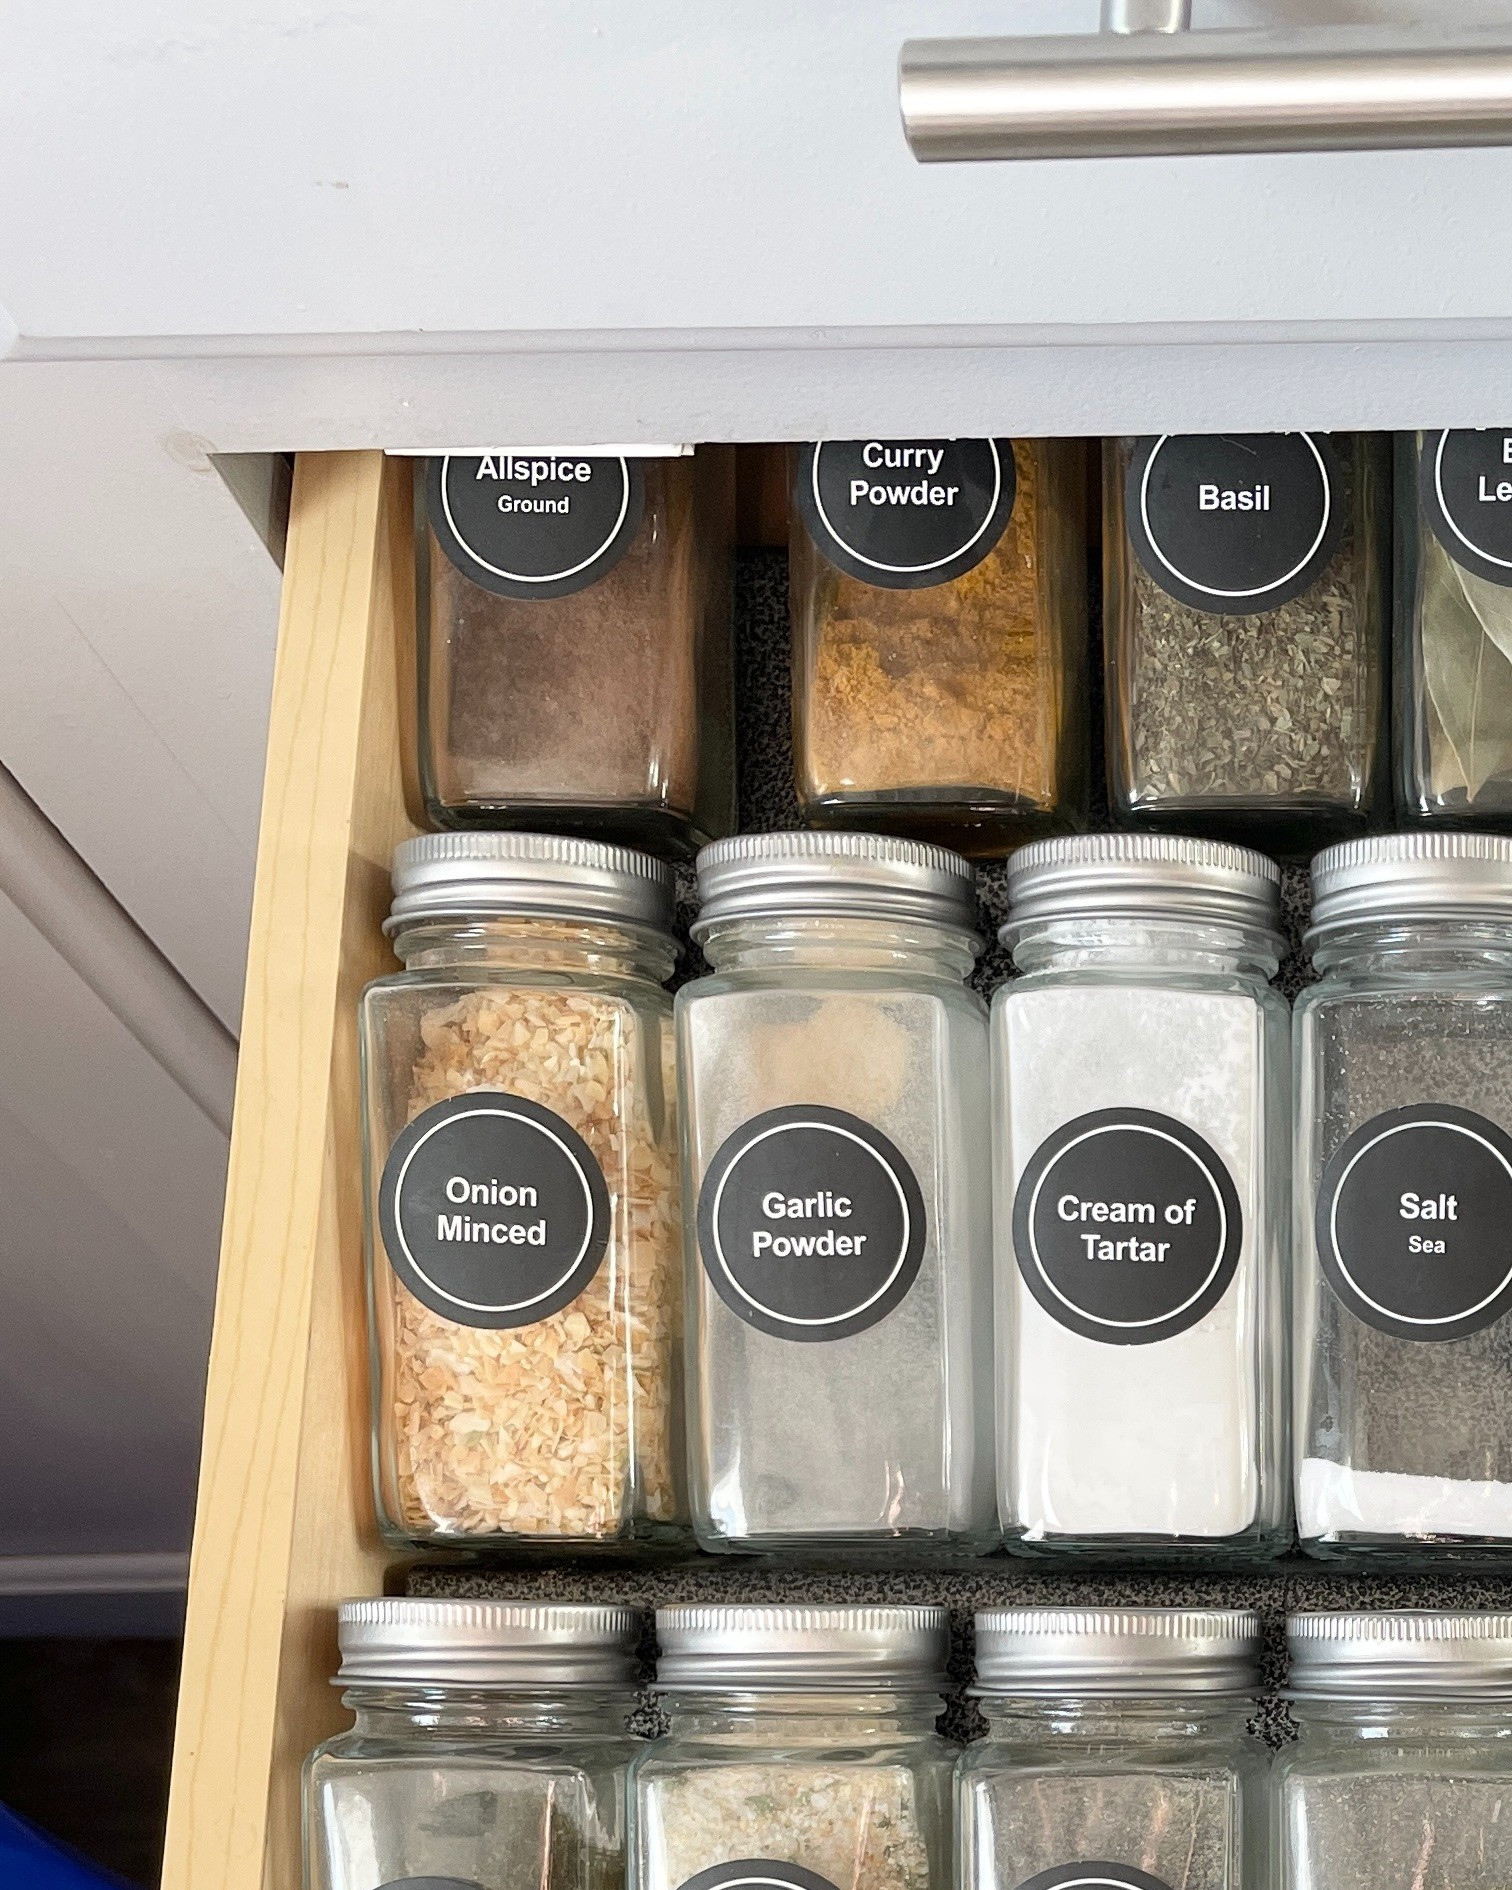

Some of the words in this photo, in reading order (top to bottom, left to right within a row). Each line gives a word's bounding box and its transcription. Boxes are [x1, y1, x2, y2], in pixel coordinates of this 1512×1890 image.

[475, 456, 592, 487] Allspice
[862, 443, 945, 475] Curry
[497, 494, 570, 514] Ground
[850, 479, 960, 506] Powder
[1199, 484, 1270, 511] Basil
[445, 1176, 537, 1207] Onion
[761, 1191, 853, 1219] Garlic
[1057, 1194, 1156, 1224] Cream
[1164, 1198, 1197, 1225] of
[1399, 1192, 1458, 1221] Salt
[437, 1214, 547, 1246] Minced
[751, 1229, 867, 1258] Powder
[1408, 1235, 1446, 1254] Sea
[1080, 1233, 1171, 1263] Tartar
